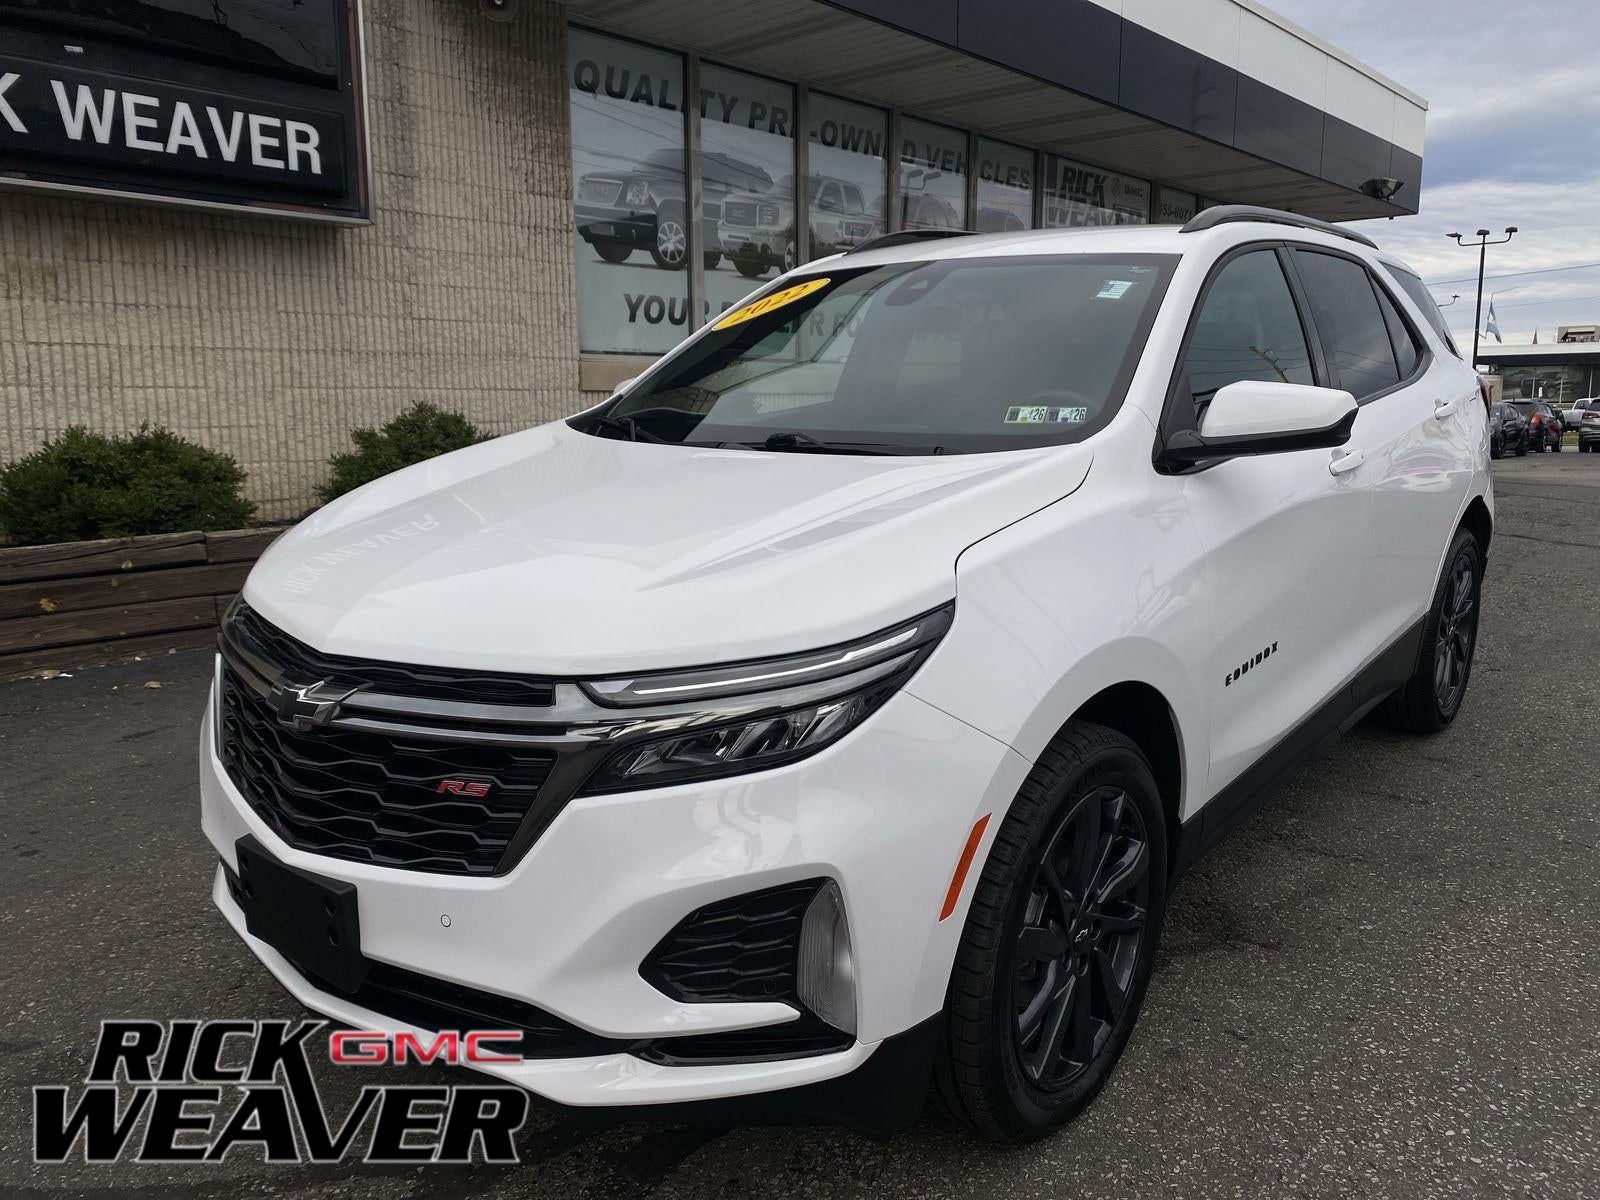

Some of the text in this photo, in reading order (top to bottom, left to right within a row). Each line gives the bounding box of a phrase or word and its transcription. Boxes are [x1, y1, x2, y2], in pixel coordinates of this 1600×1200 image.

[574, 59, 739, 124] QUALTY
[50, 79, 322, 175] WEAVER
[1061, 166, 1107, 200] RICK
[732, 283, 809, 323] 2022
[1033, 408, 1045, 421] 26
[1074, 408, 1086, 421] 26
[1225, 641, 1278, 687] EQUINOX
[436, 780, 492, 797] RS
